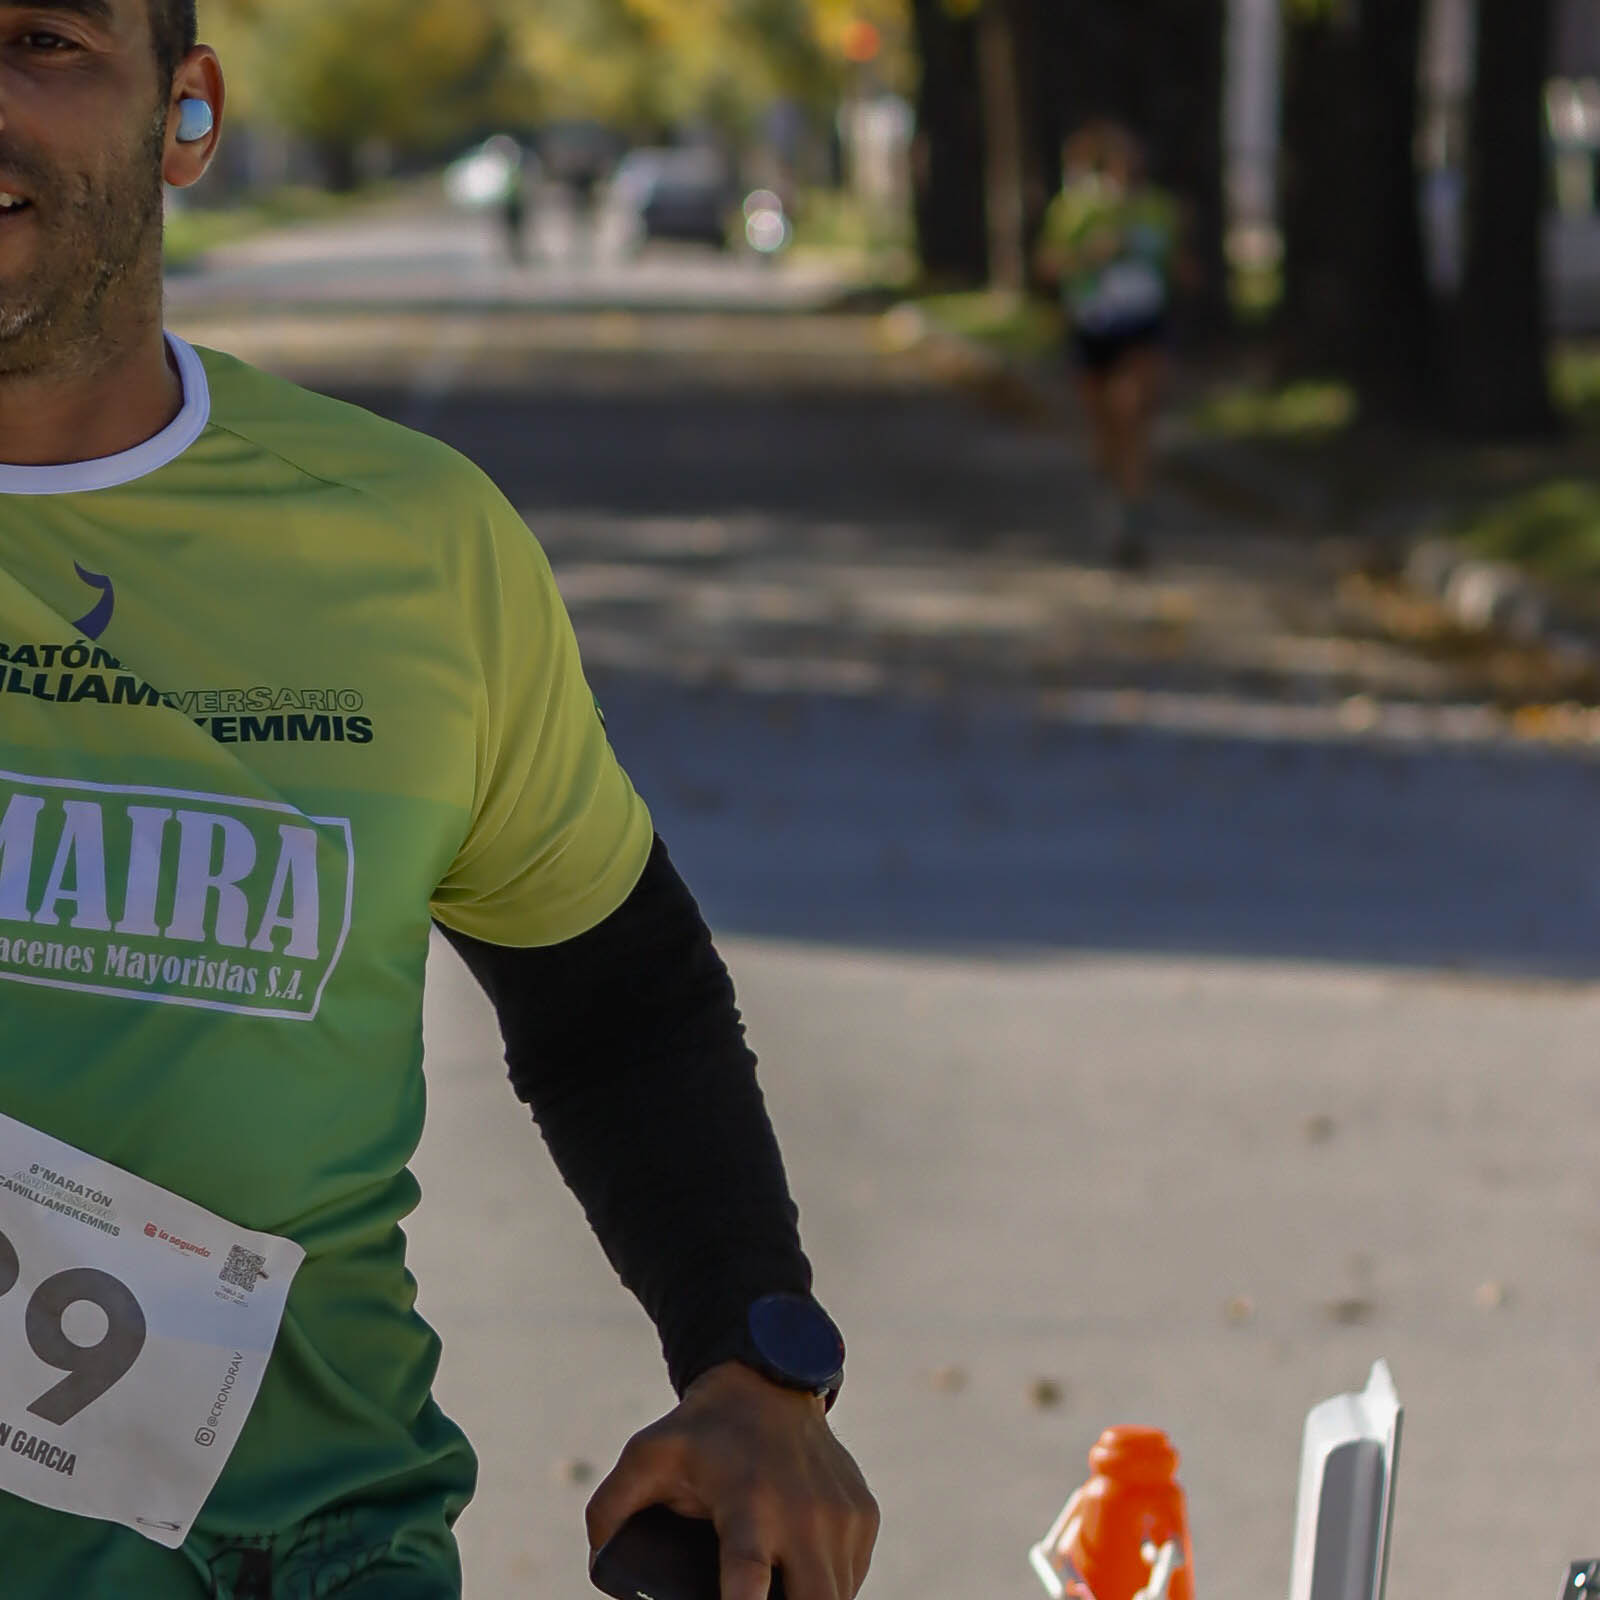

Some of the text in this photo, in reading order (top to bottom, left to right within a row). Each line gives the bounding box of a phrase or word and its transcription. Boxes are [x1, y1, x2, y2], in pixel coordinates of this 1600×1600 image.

[103, 944, 257, 996] Mayoristas
[265, 967, 304, 1001] S.A.
[158, 1229, 169, 1241] la
[168, 1235, 212, 1258] segunda
[207, 1351, 243, 1427] @CRONORAV
[10, 1429, 78, 1477] GARCIA
